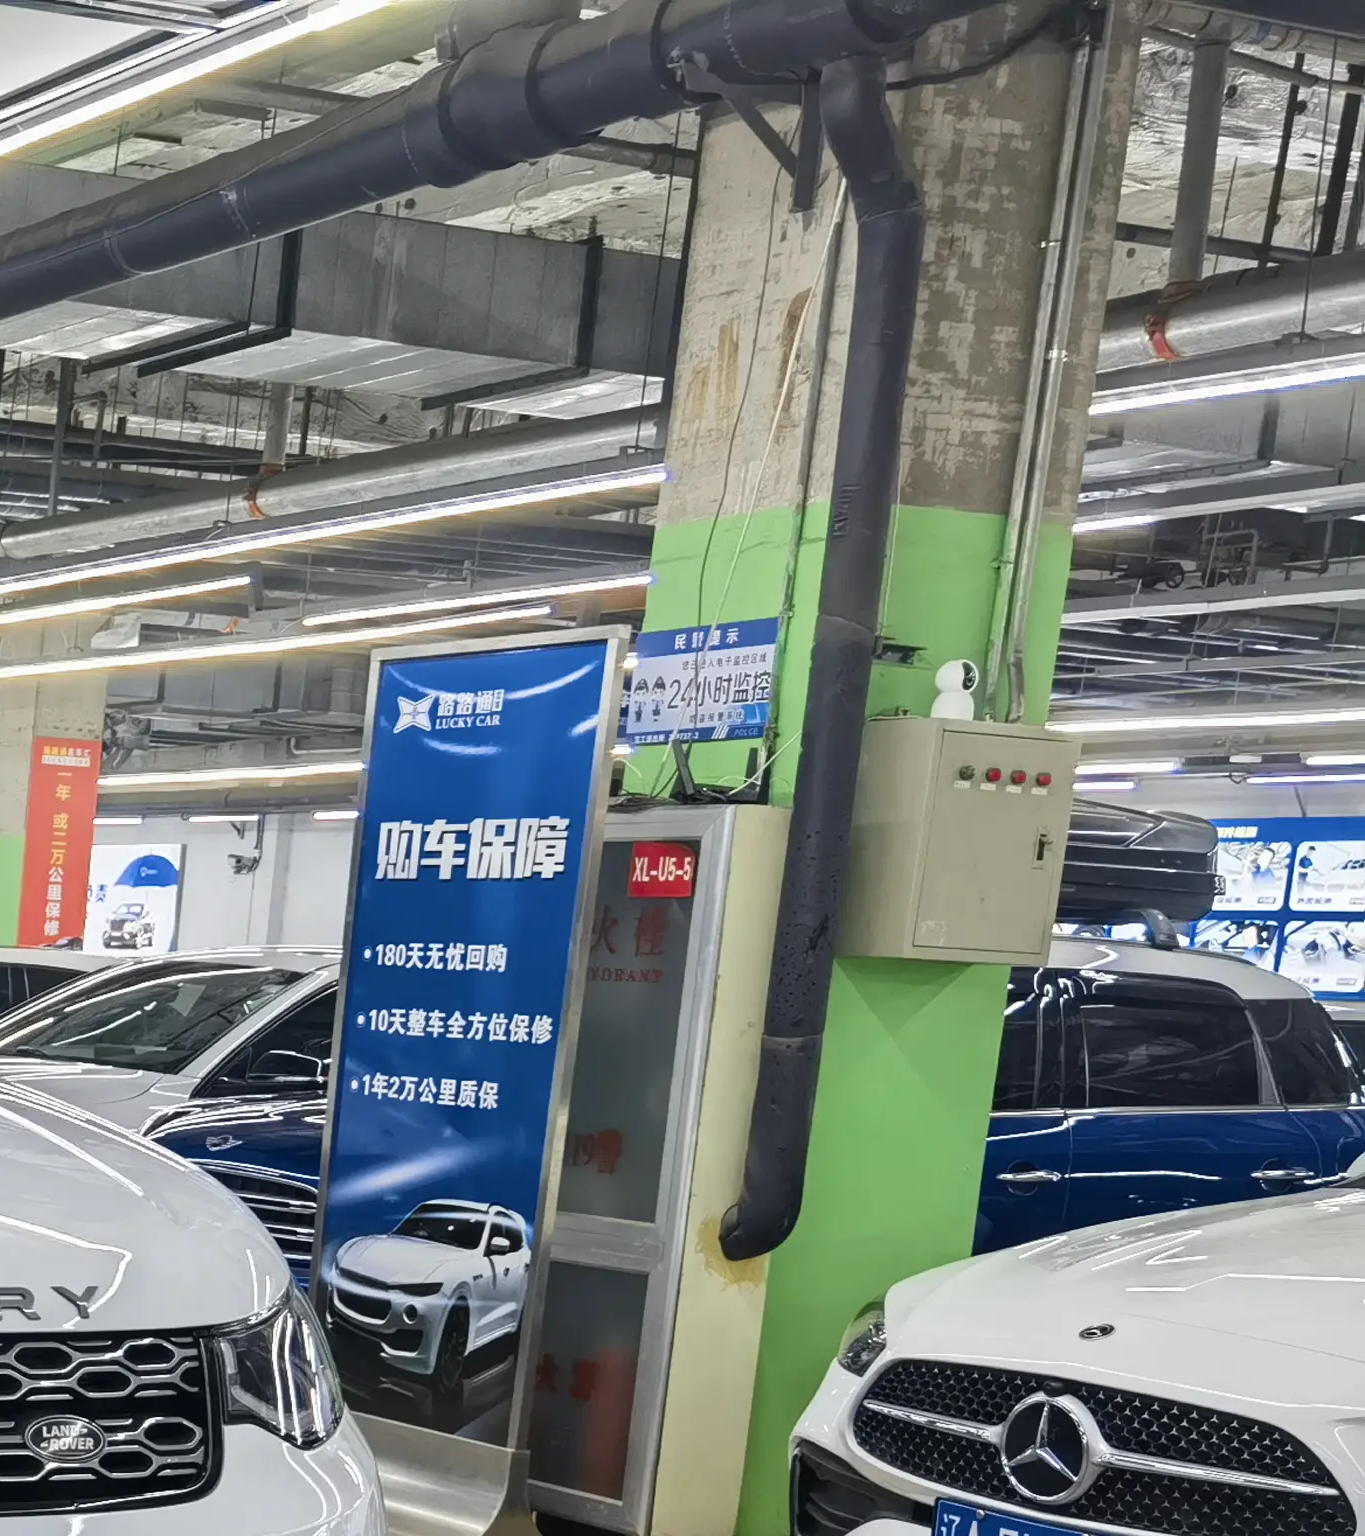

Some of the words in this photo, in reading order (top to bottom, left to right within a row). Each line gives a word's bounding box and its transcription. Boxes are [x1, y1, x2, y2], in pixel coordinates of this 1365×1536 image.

[435, 717, 472, 730] LUCKY
[475, 714, 501, 727] CAR
[375, 815, 570, 880] 购车保障
[632, 856, 694, 883] XL-U5-5
[376, 942, 509, 973] 180天无忧回购
[369, 1008, 554, 1045] 10天整车全方位保修
[362, 1073, 500, 1110] 1年2万公里质保
[42, 1425, 80, 1438] LAND
[51, 1437, 95, 1450] ROVER
